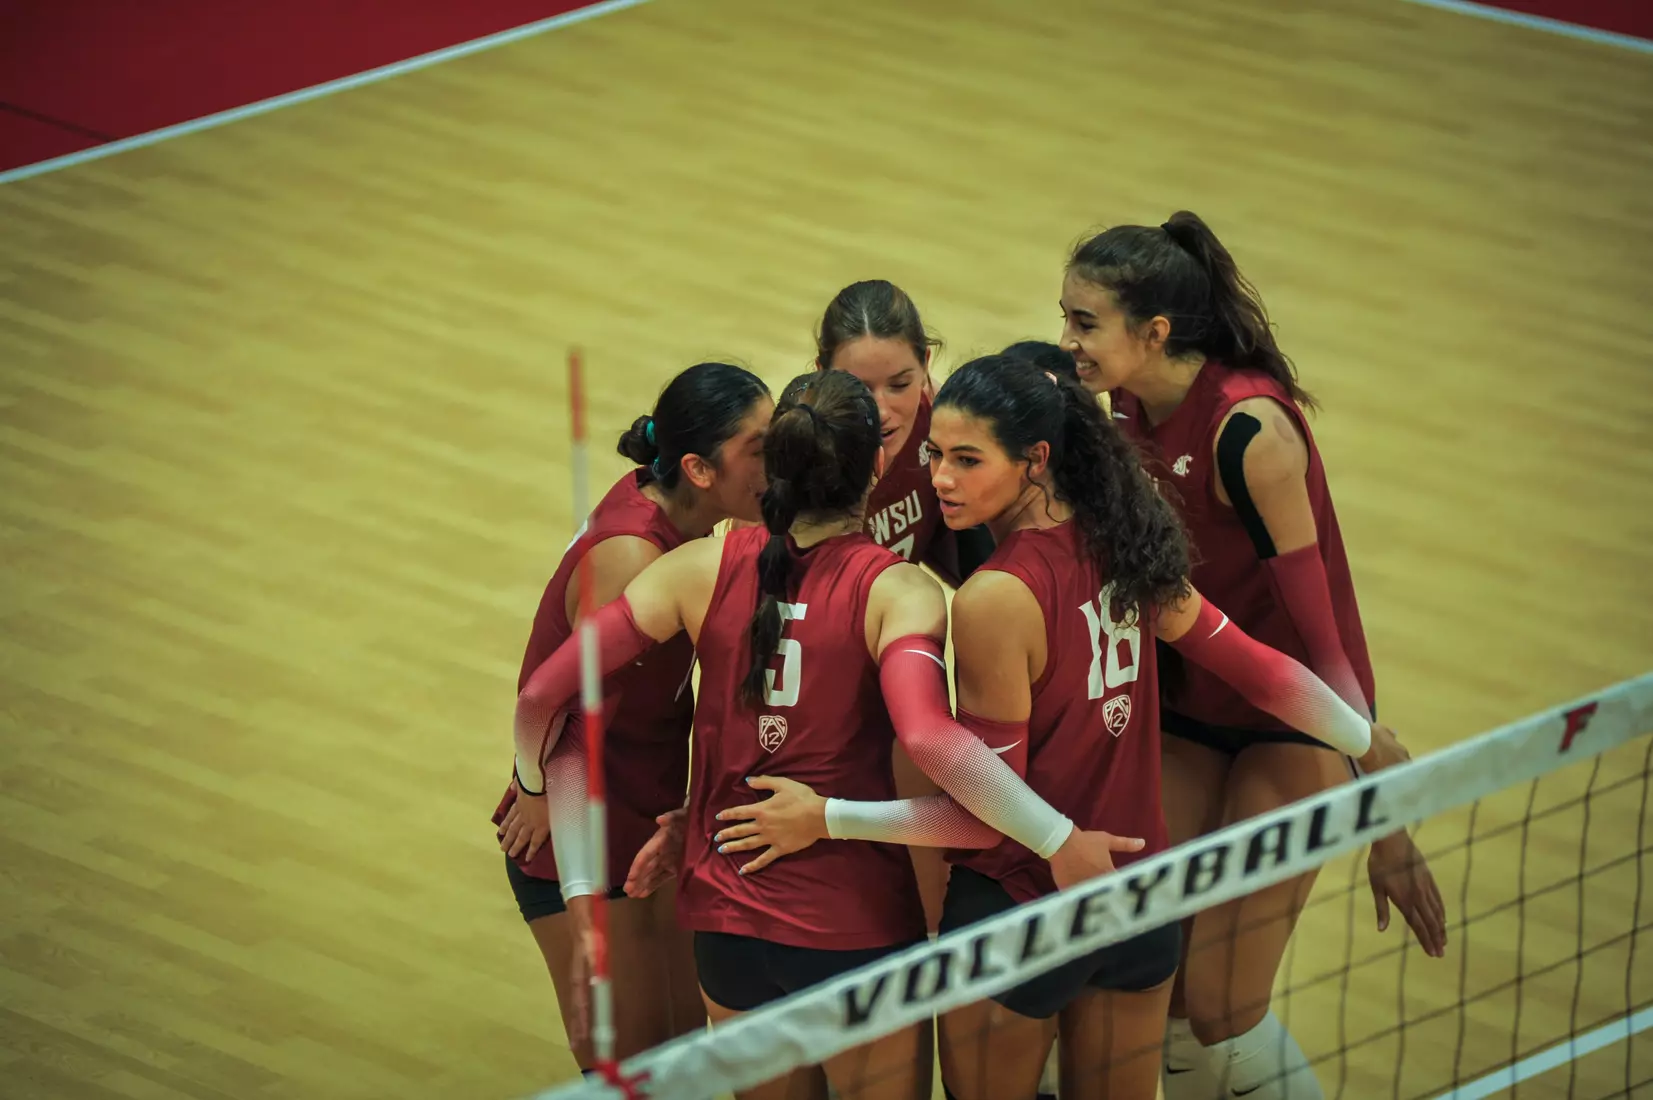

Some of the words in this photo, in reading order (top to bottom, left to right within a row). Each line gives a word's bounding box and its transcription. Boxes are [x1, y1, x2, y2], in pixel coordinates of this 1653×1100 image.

[868, 490, 922, 545] WSU
[763, 601, 808, 707] 5
[1078, 580, 1141, 700] 18
[760, 717, 786, 738] PAC
[764, 731, 781, 746] 12
[1109, 713, 1125, 729] 12
[1558, 702, 1598, 753] F
[840, 785, 1392, 1028] VOLLEYBALL
